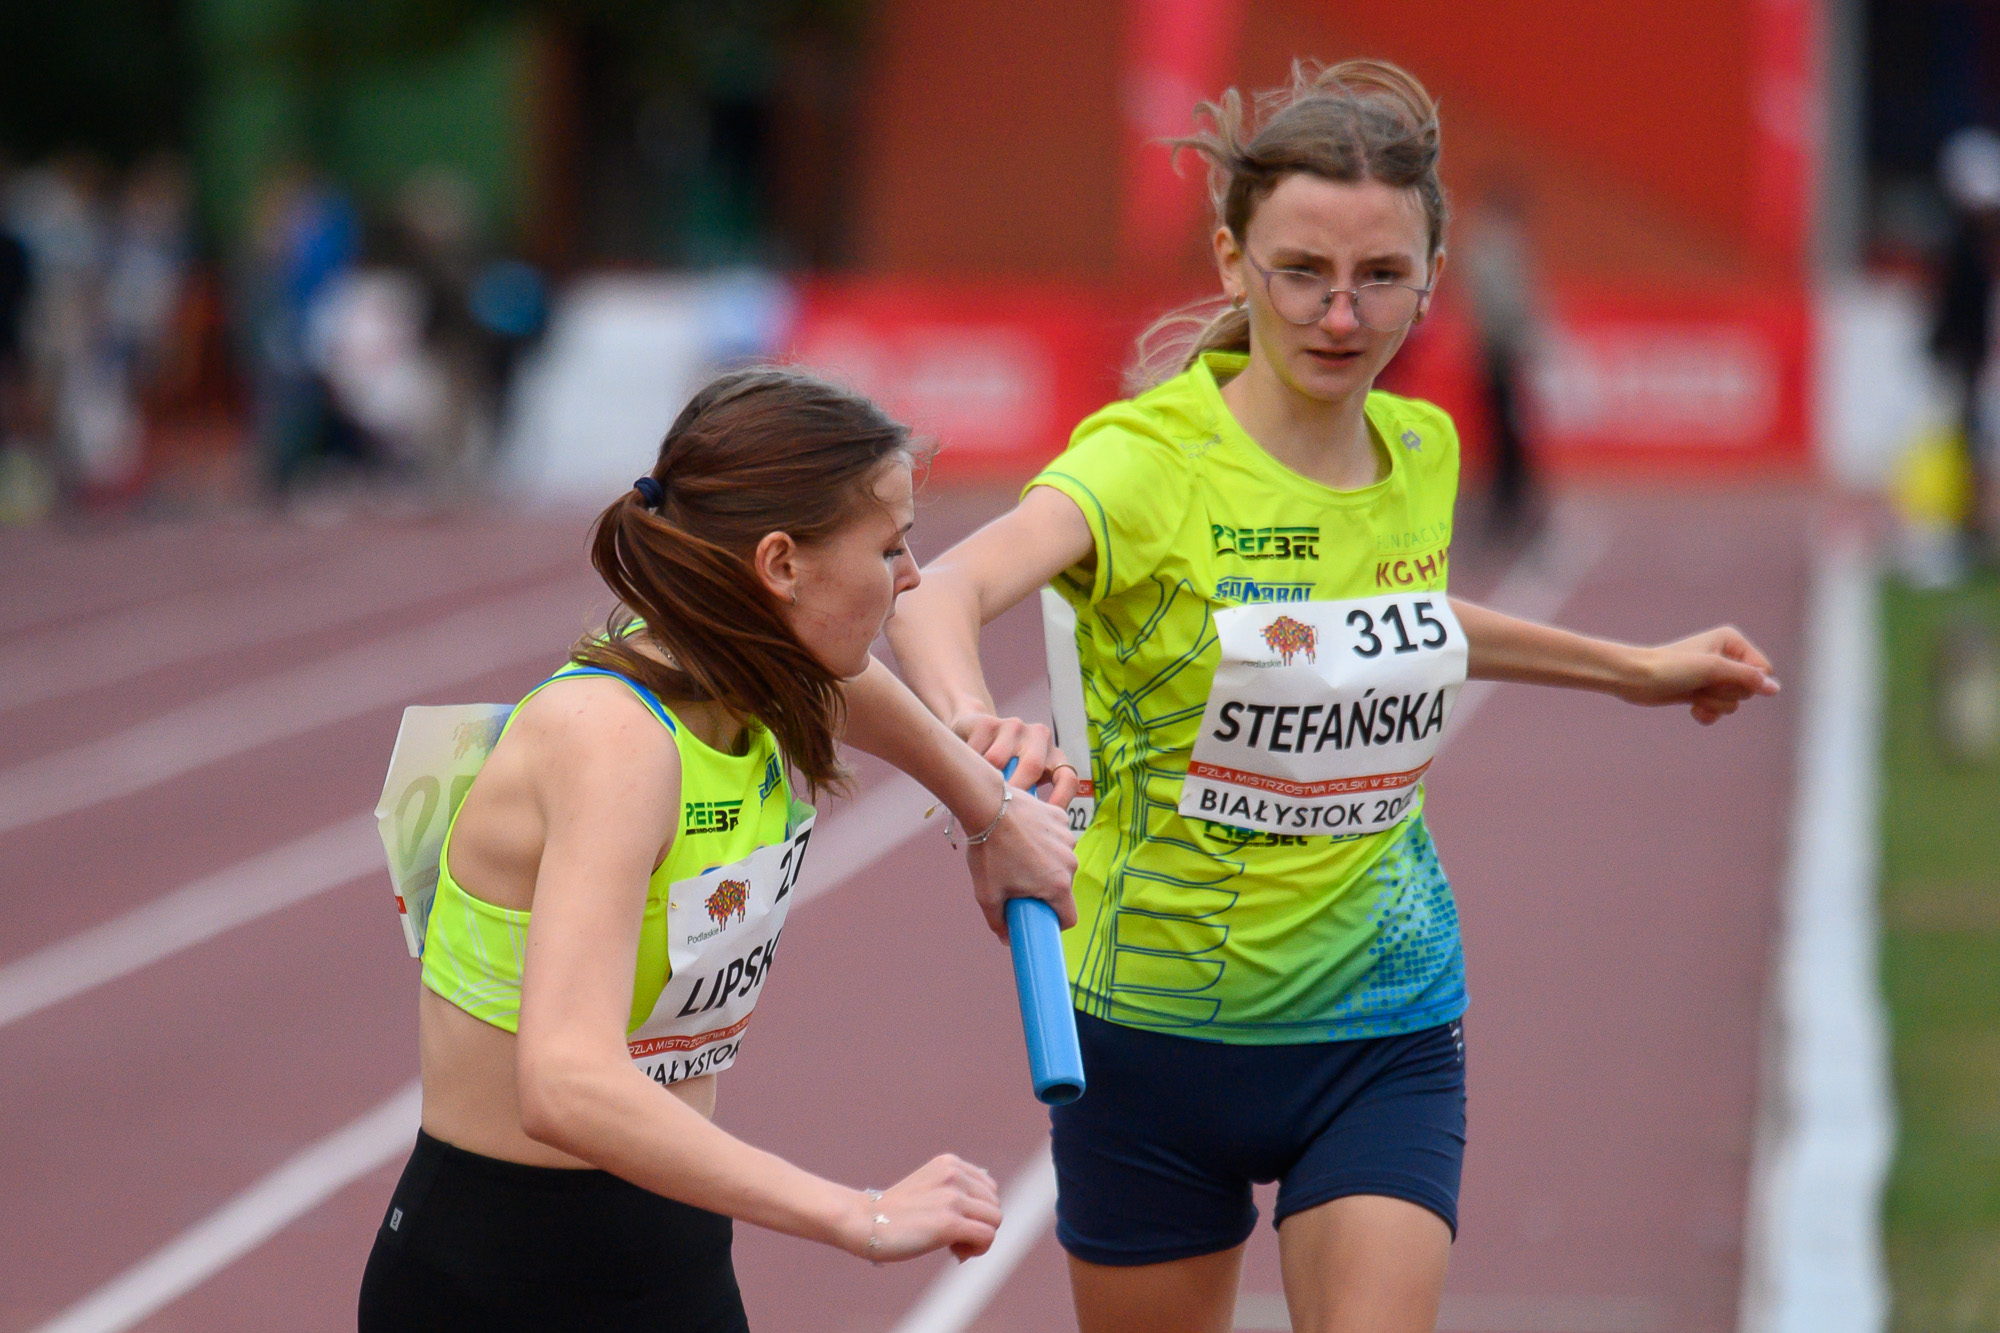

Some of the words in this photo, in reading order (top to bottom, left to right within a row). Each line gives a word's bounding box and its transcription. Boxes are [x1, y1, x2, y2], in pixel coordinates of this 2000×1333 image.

[1346, 602, 1448, 659] 315
[1212, 688, 1445, 753] STEFAŃSKA
[1197, 765, 1232, 780] PZLA
[1235, 774, 1325, 795] MISTRZOSTWA
[1328, 780, 1367, 792] POLSKI
[1370, 779, 1381, 788] W
[1199, 788, 1365, 828] BIAŁYSTOK
[774, 827, 812, 905] 27
[687, 928, 719, 945] Podlaskie
[655, 1031, 726, 1050] MISTRZOSTWA
